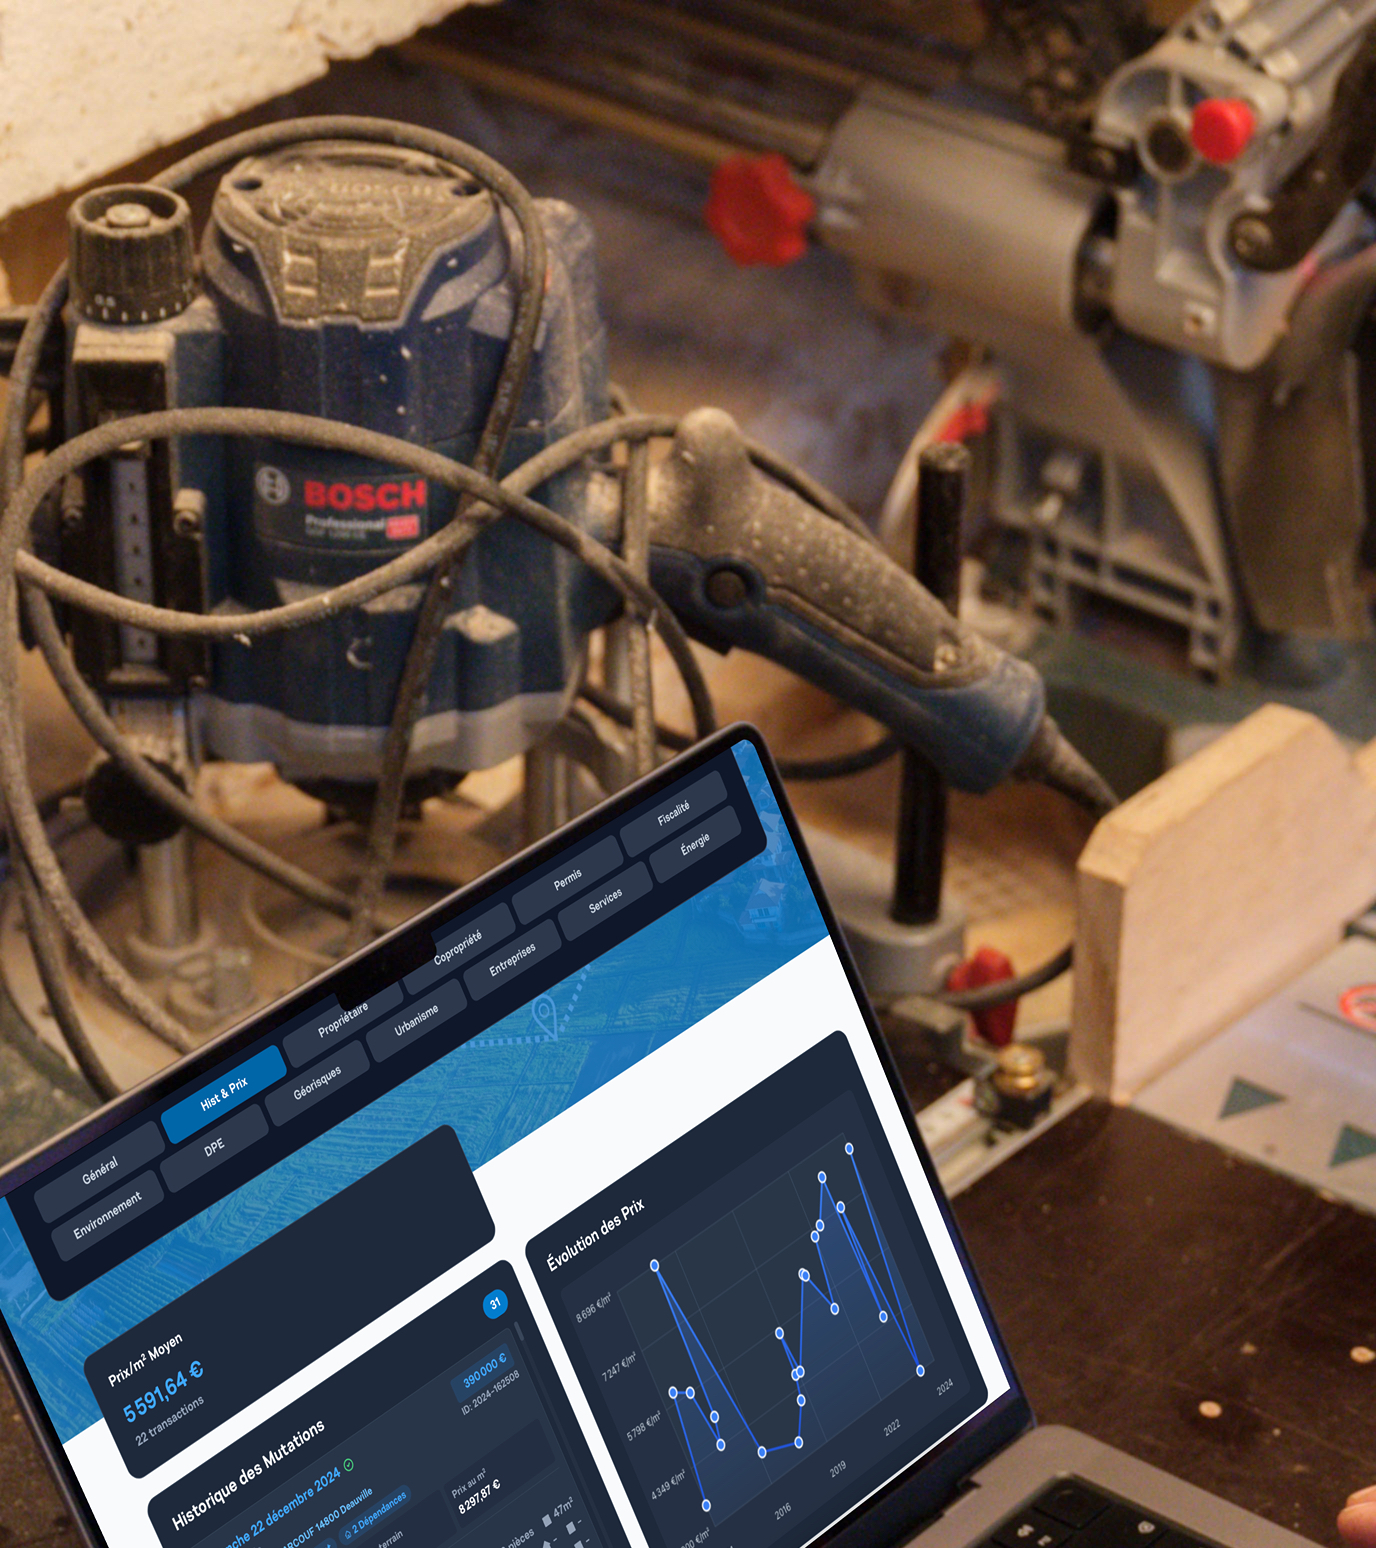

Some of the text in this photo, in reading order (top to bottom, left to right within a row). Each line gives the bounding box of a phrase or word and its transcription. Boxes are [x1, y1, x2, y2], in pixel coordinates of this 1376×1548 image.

[304, 480, 426, 511] BOSCH
[657, 799, 691, 827] Fiscalité
[680, 833, 711, 856] Énergie
[553, 869, 583, 891] Permis
[588, 888, 623, 914] Services
[433, 929, 483, 966] Copropriété
[488, 943, 537, 977] Entreprises
[317, 1002, 369, 1039] Propriétaire
[393, 1004, 439, 1037] Urbanisme
[200, 1077, 249, 1112] Hist & Prix
[293, 1066, 342, 1101] Géorisques
[203, 1137, 226, 1158] DPE
[81, 1155, 119, 1185] Général
[72, 1191, 143, 1240] Environnement
[546, 1198, 645, 1272] Évolution des Prix
[489, 1296, 501, 1310] 31
[147, 1333, 184, 1362] Moyen
[460, 1369, 520, 1416] ID: 2024-162508
[134, 1396, 205, 1447] 22 transactions
[774, 1502, 792, 1521] 2016
[829, 1460, 847, 1478] 2019
[883, 1418, 902, 1437] 2022
[936, 1378, 954, 1396] 2024
[171, 1420, 326, 1531] Historique des Mutations
[451, 1484, 468, 1499] Prix
[466, 1477, 478, 1489] au
[250, 1519, 266, 1537] 22
[265, 1487, 315, 1527] décembre
[313, 1466, 341, 1493] 2024
[314, 1509, 341, 1532] 14800
[339, 1488, 373, 1515] Deauville
[351, 1491, 407, 1534] 2 Dépendances
